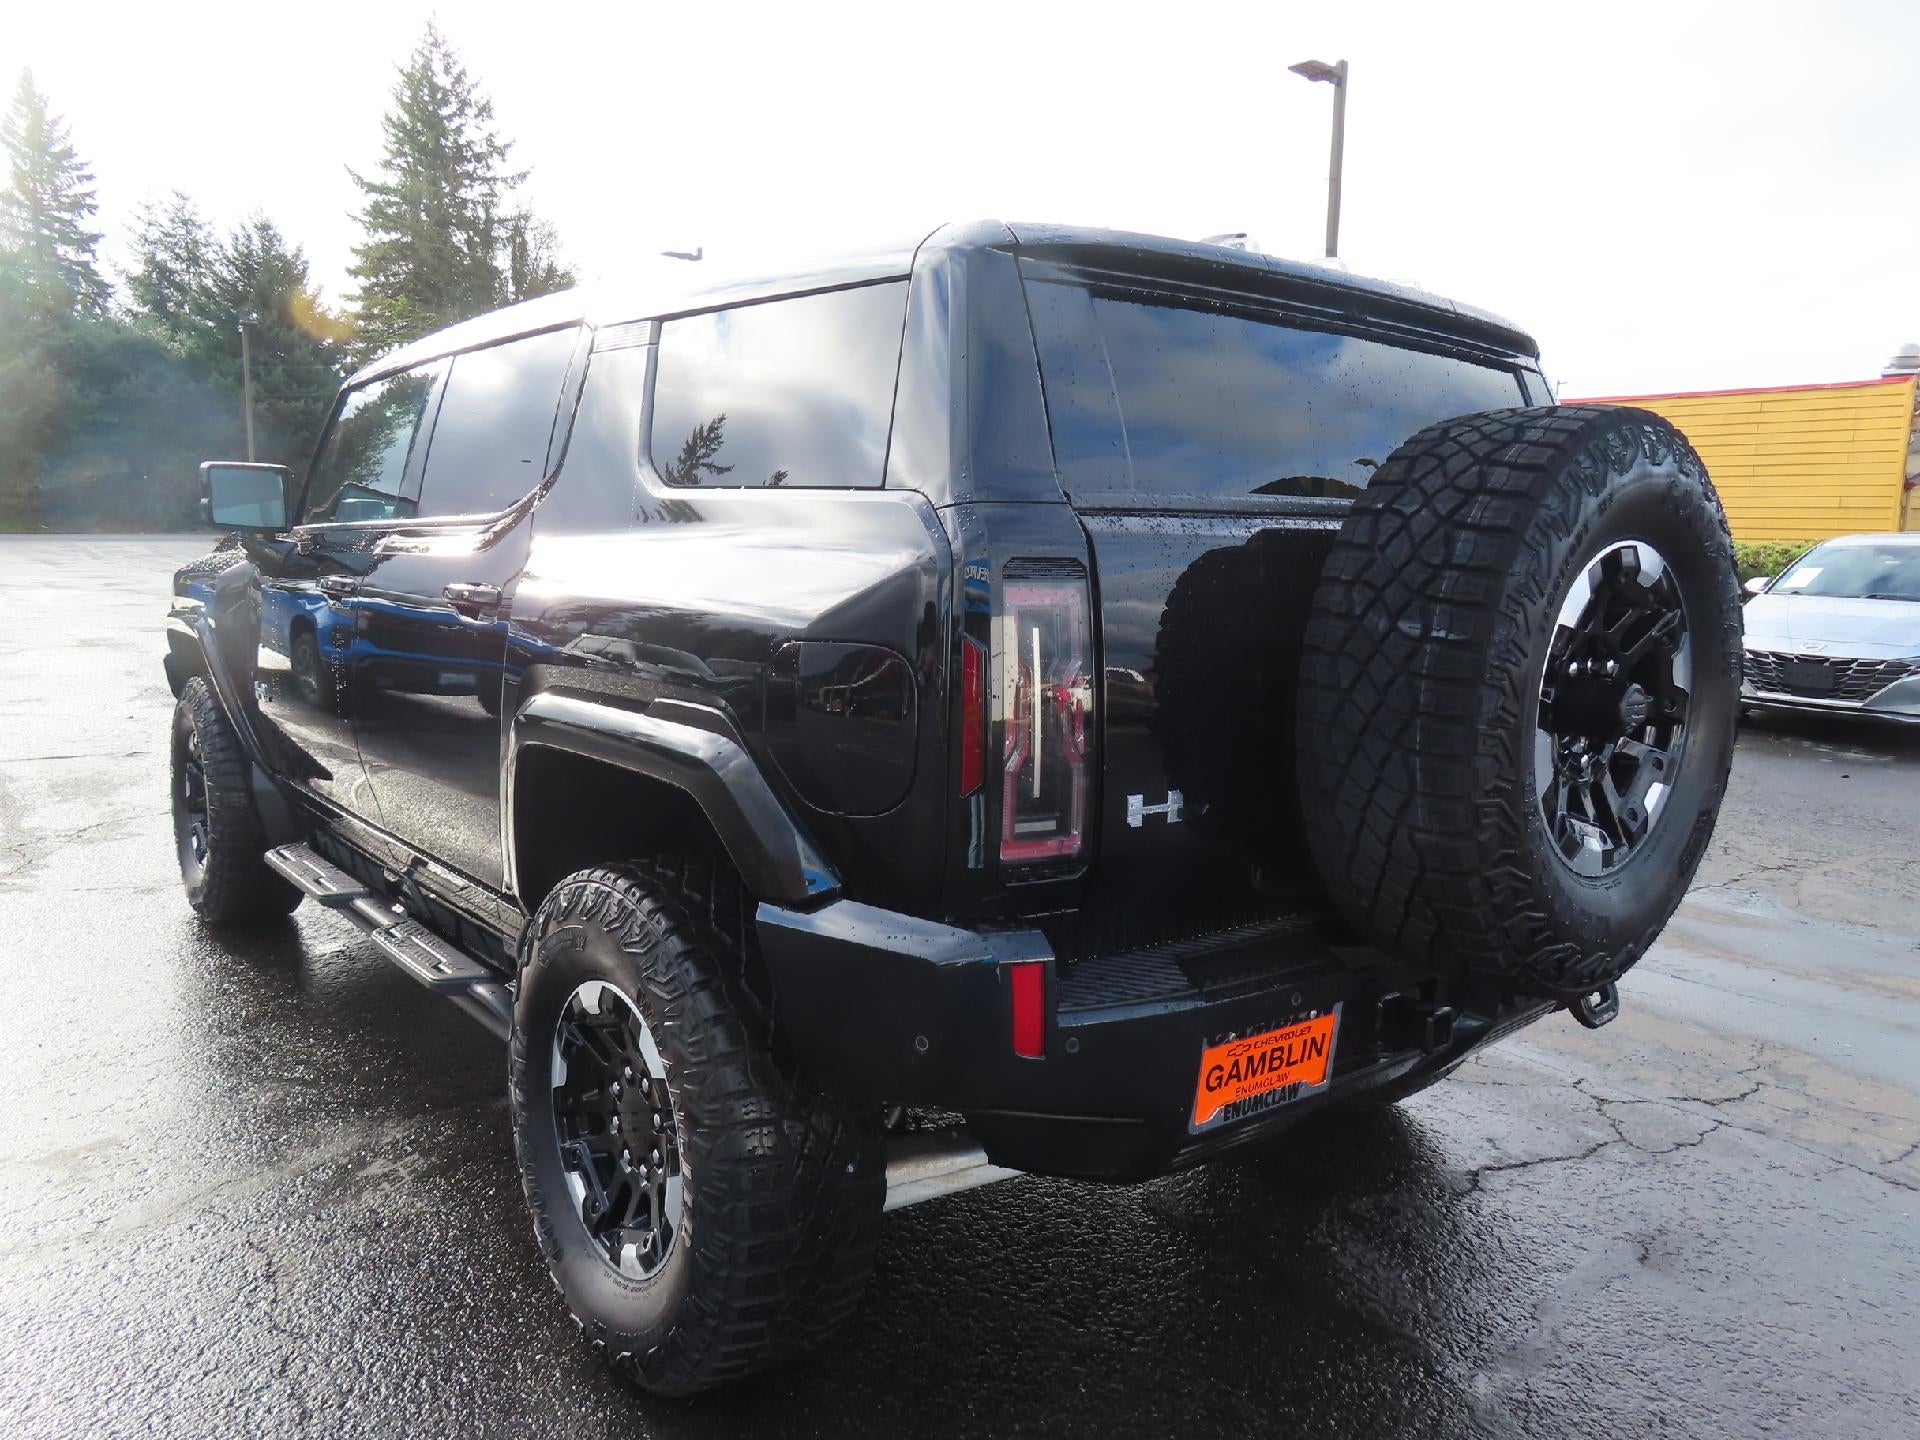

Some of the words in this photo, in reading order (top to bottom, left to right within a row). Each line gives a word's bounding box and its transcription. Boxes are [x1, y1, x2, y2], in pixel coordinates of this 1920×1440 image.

[1253, 1025, 1312, 1049] CHEVROLET
[1205, 1033, 1326, 1092] GAMBLIN
[1223, 1081, 1301, 1122] ENUMCLAW
[1235, 1071, 1291, 1098] ENUMCLAW
